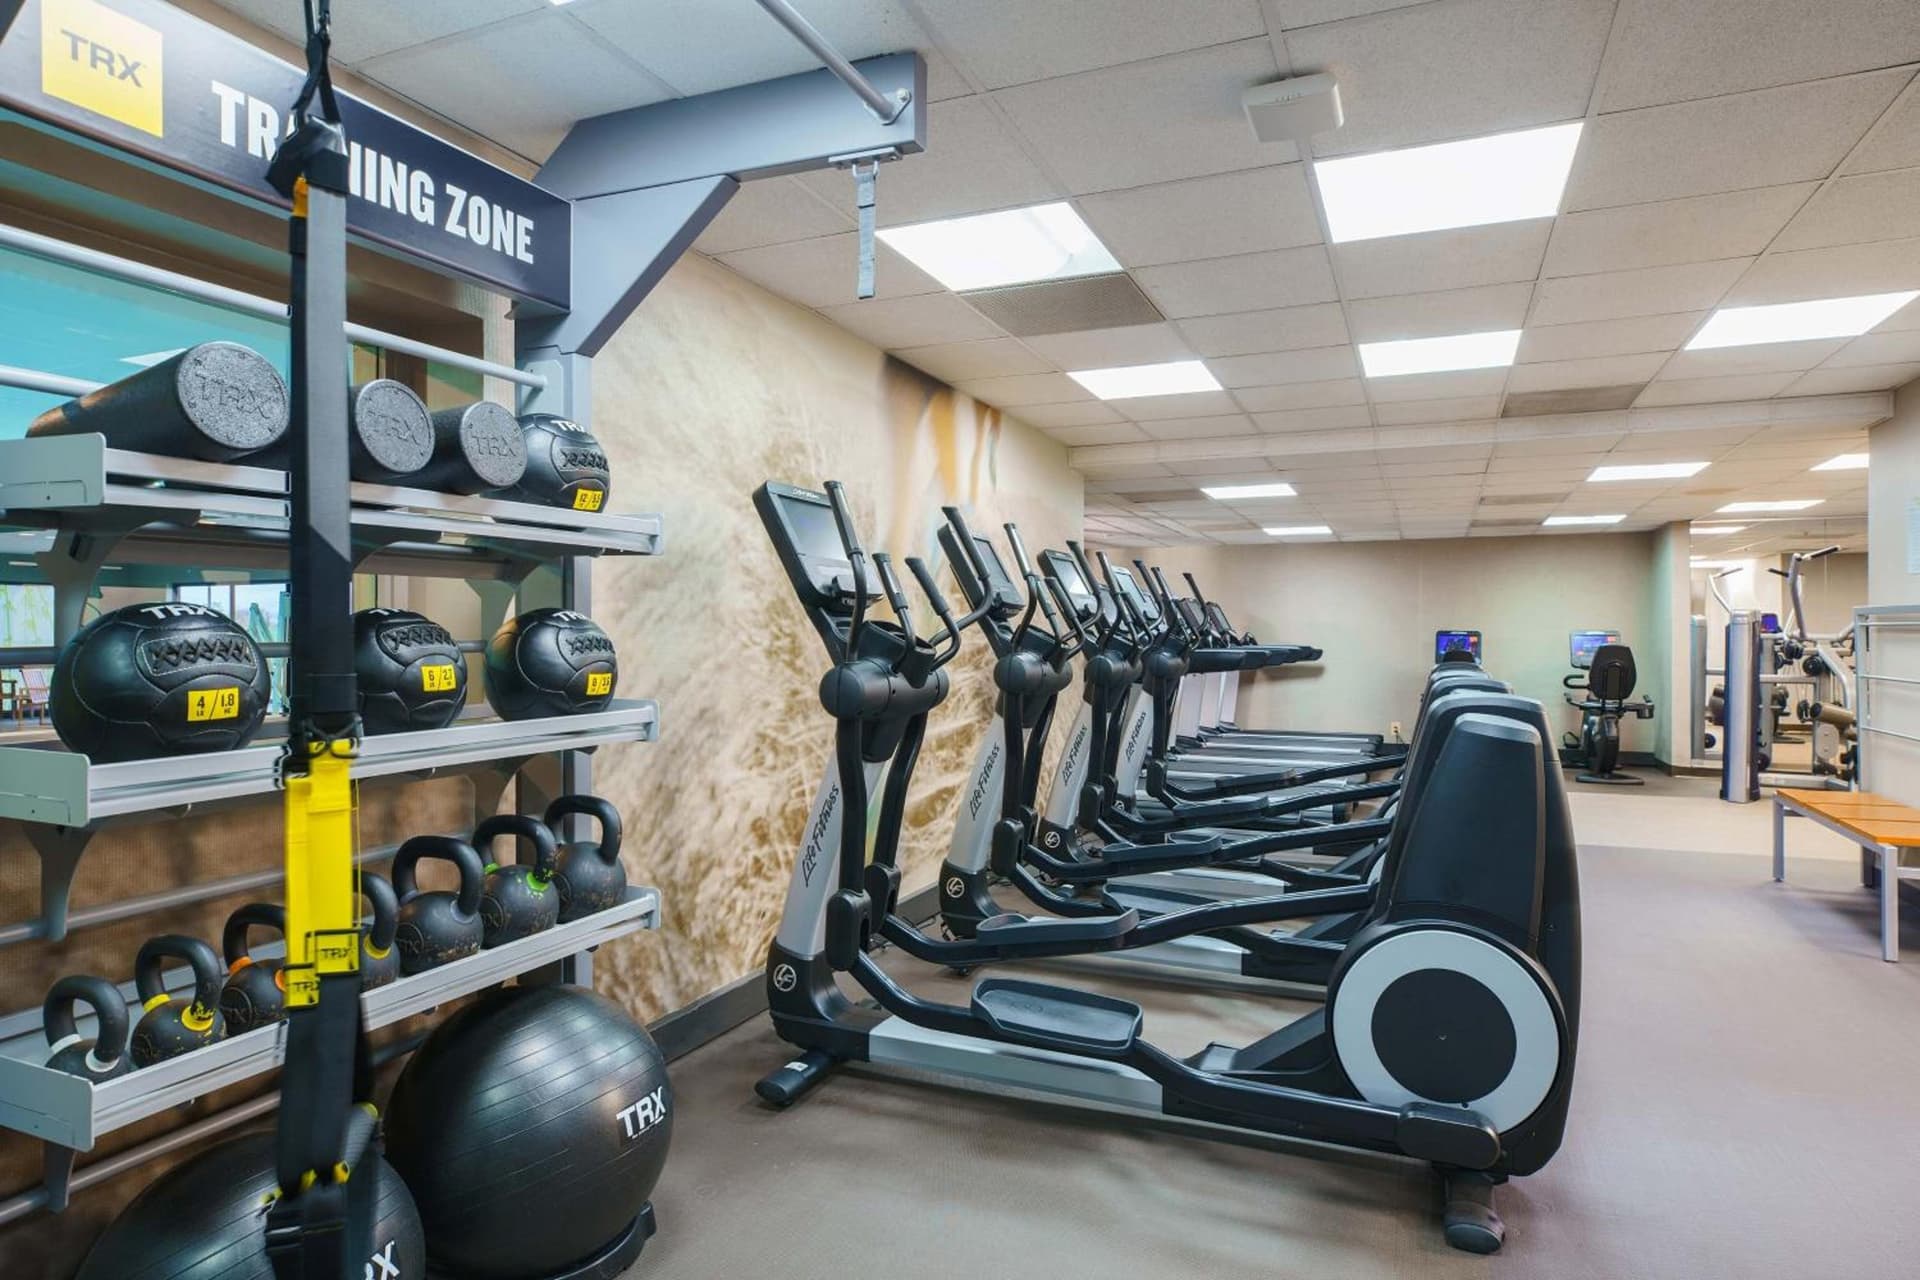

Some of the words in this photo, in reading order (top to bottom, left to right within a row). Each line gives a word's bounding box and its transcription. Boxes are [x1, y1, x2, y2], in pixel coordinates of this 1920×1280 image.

[60, 28, 143, 88] TRX
[211, 79, 435, 226] TRING
[445, 183, 535, 264] ZONE
[140, 604, 220, 620] TRX
[428, 670, 435, 681] 6
[196, 695, 205, 709] 4
[320, 947, 351, 960] TRX
[615, 1086, 667, 1138] TRX
